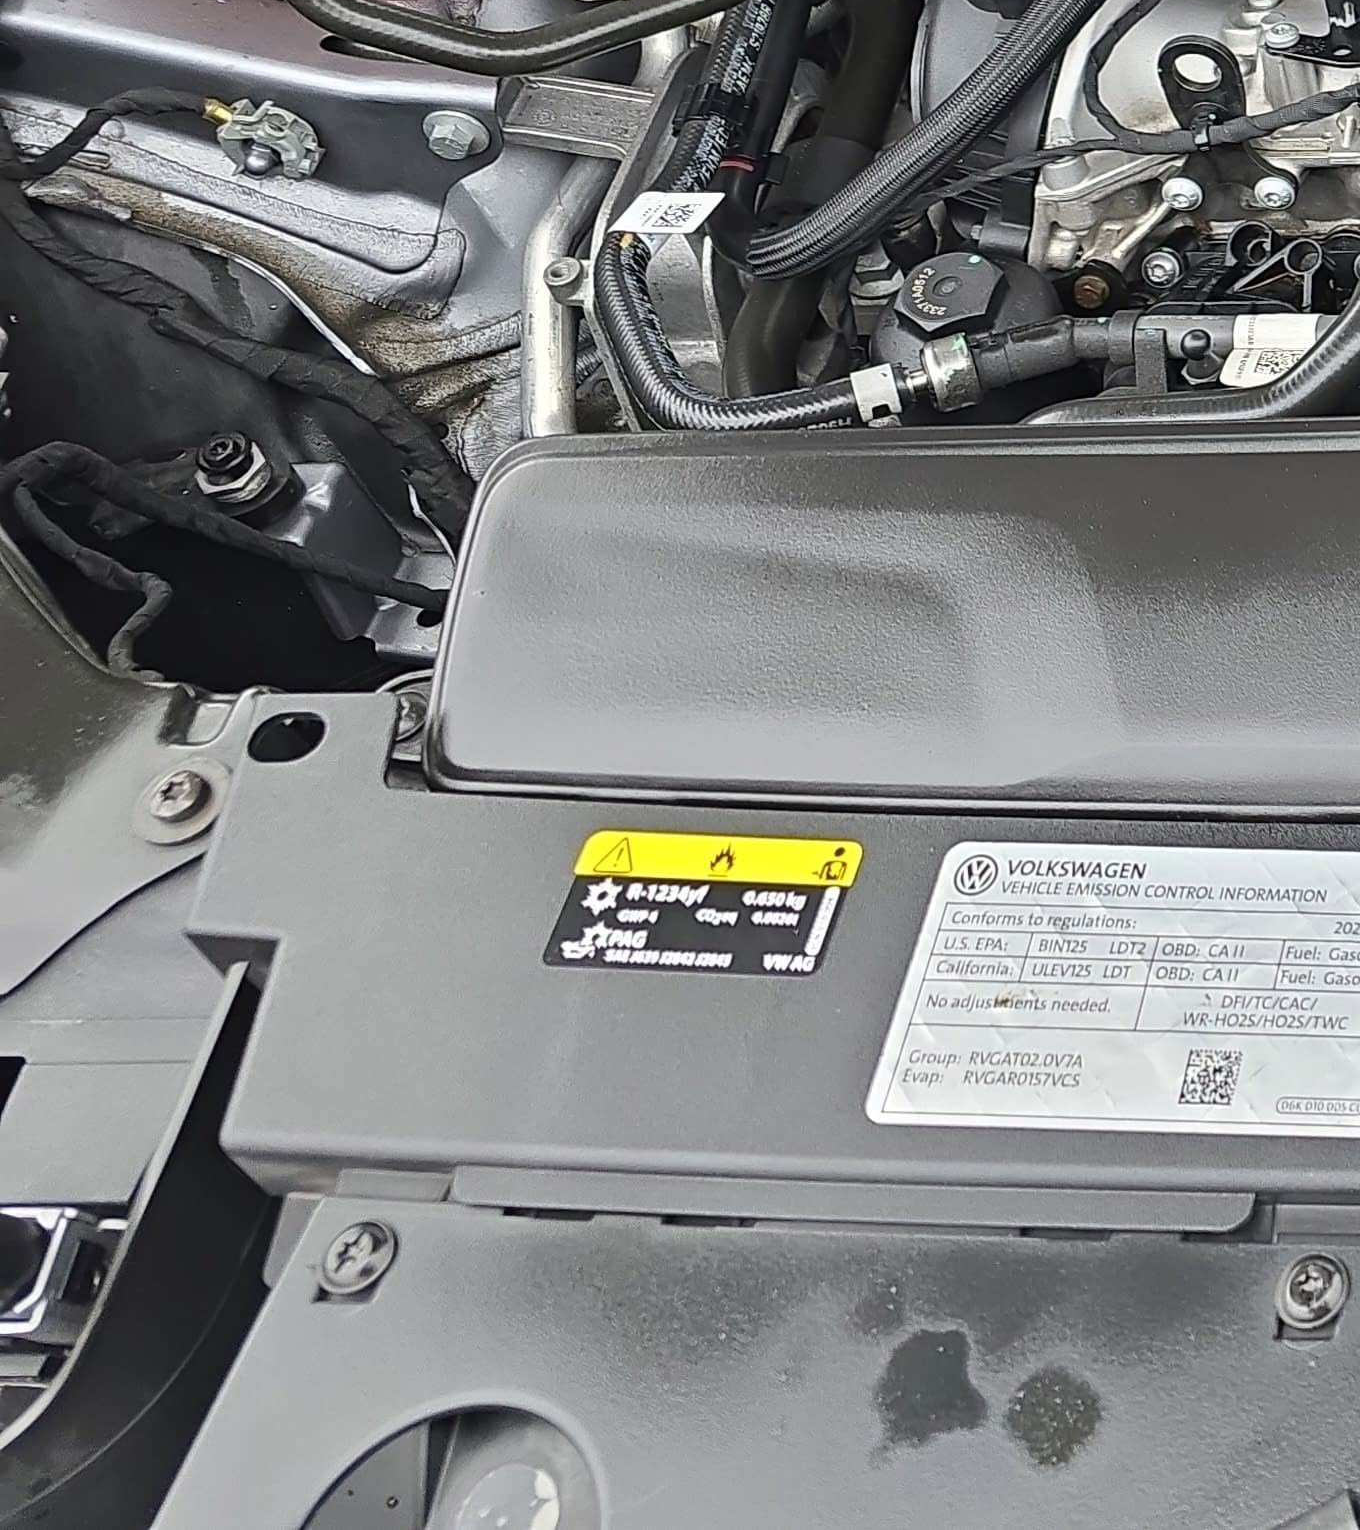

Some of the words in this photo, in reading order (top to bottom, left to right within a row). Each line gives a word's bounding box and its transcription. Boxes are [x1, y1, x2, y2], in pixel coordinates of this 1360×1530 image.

[911, 267, 948, 316] 23371A0512
[1009, 860, 1146, 879] VOLKSWAGEN
[1002, 881, 1063, 895] VEHICLE
[1066, 882, 1141, 897] EMISSION
[1144, 885, 1214, 900] CONTROL
[1219, 887, 1327, 903] INFORMATION
[952, 910, 1024, 926] Conforms
[1028, 912, 1044, 926] to
[1047, 914, 1136, 931] regulations:
[605, 929, 648, 949] PAG
[943, 936, 970, 951] U.S.
[975, 937, 1008, 952] EPA:
[1038, 938, 1088, 954] BIN125
[1109, 941, 1147, 956] LDT2
[1161, 942, 1200, 957] OBD:
[1285, 945, 1321, 961] Fuel:
[763, 953, 793, 971] VW
[789, 954, 816, 972] AG
[936, 960, 1013, 976] California:
[1032, 963, 1092, 978] ULEV125
[1102, 965, 1132, 979] LDT
[1155, 966, 1195, 981] OBD:
[1280, 969, 1316, 985] Fuel:
[926, 994, 948, 1008] No
[1051, 998, 1110, 1013] needed.
[1221, 995, 1318, 1011] DFI/TC/CAC/
[1183, 1012, 1348, 1030] WR-HO2S/HO2S/TWC
[909, 1049, 962, 1069] Group:
[902, 1068, 944, 1087] Evap:
